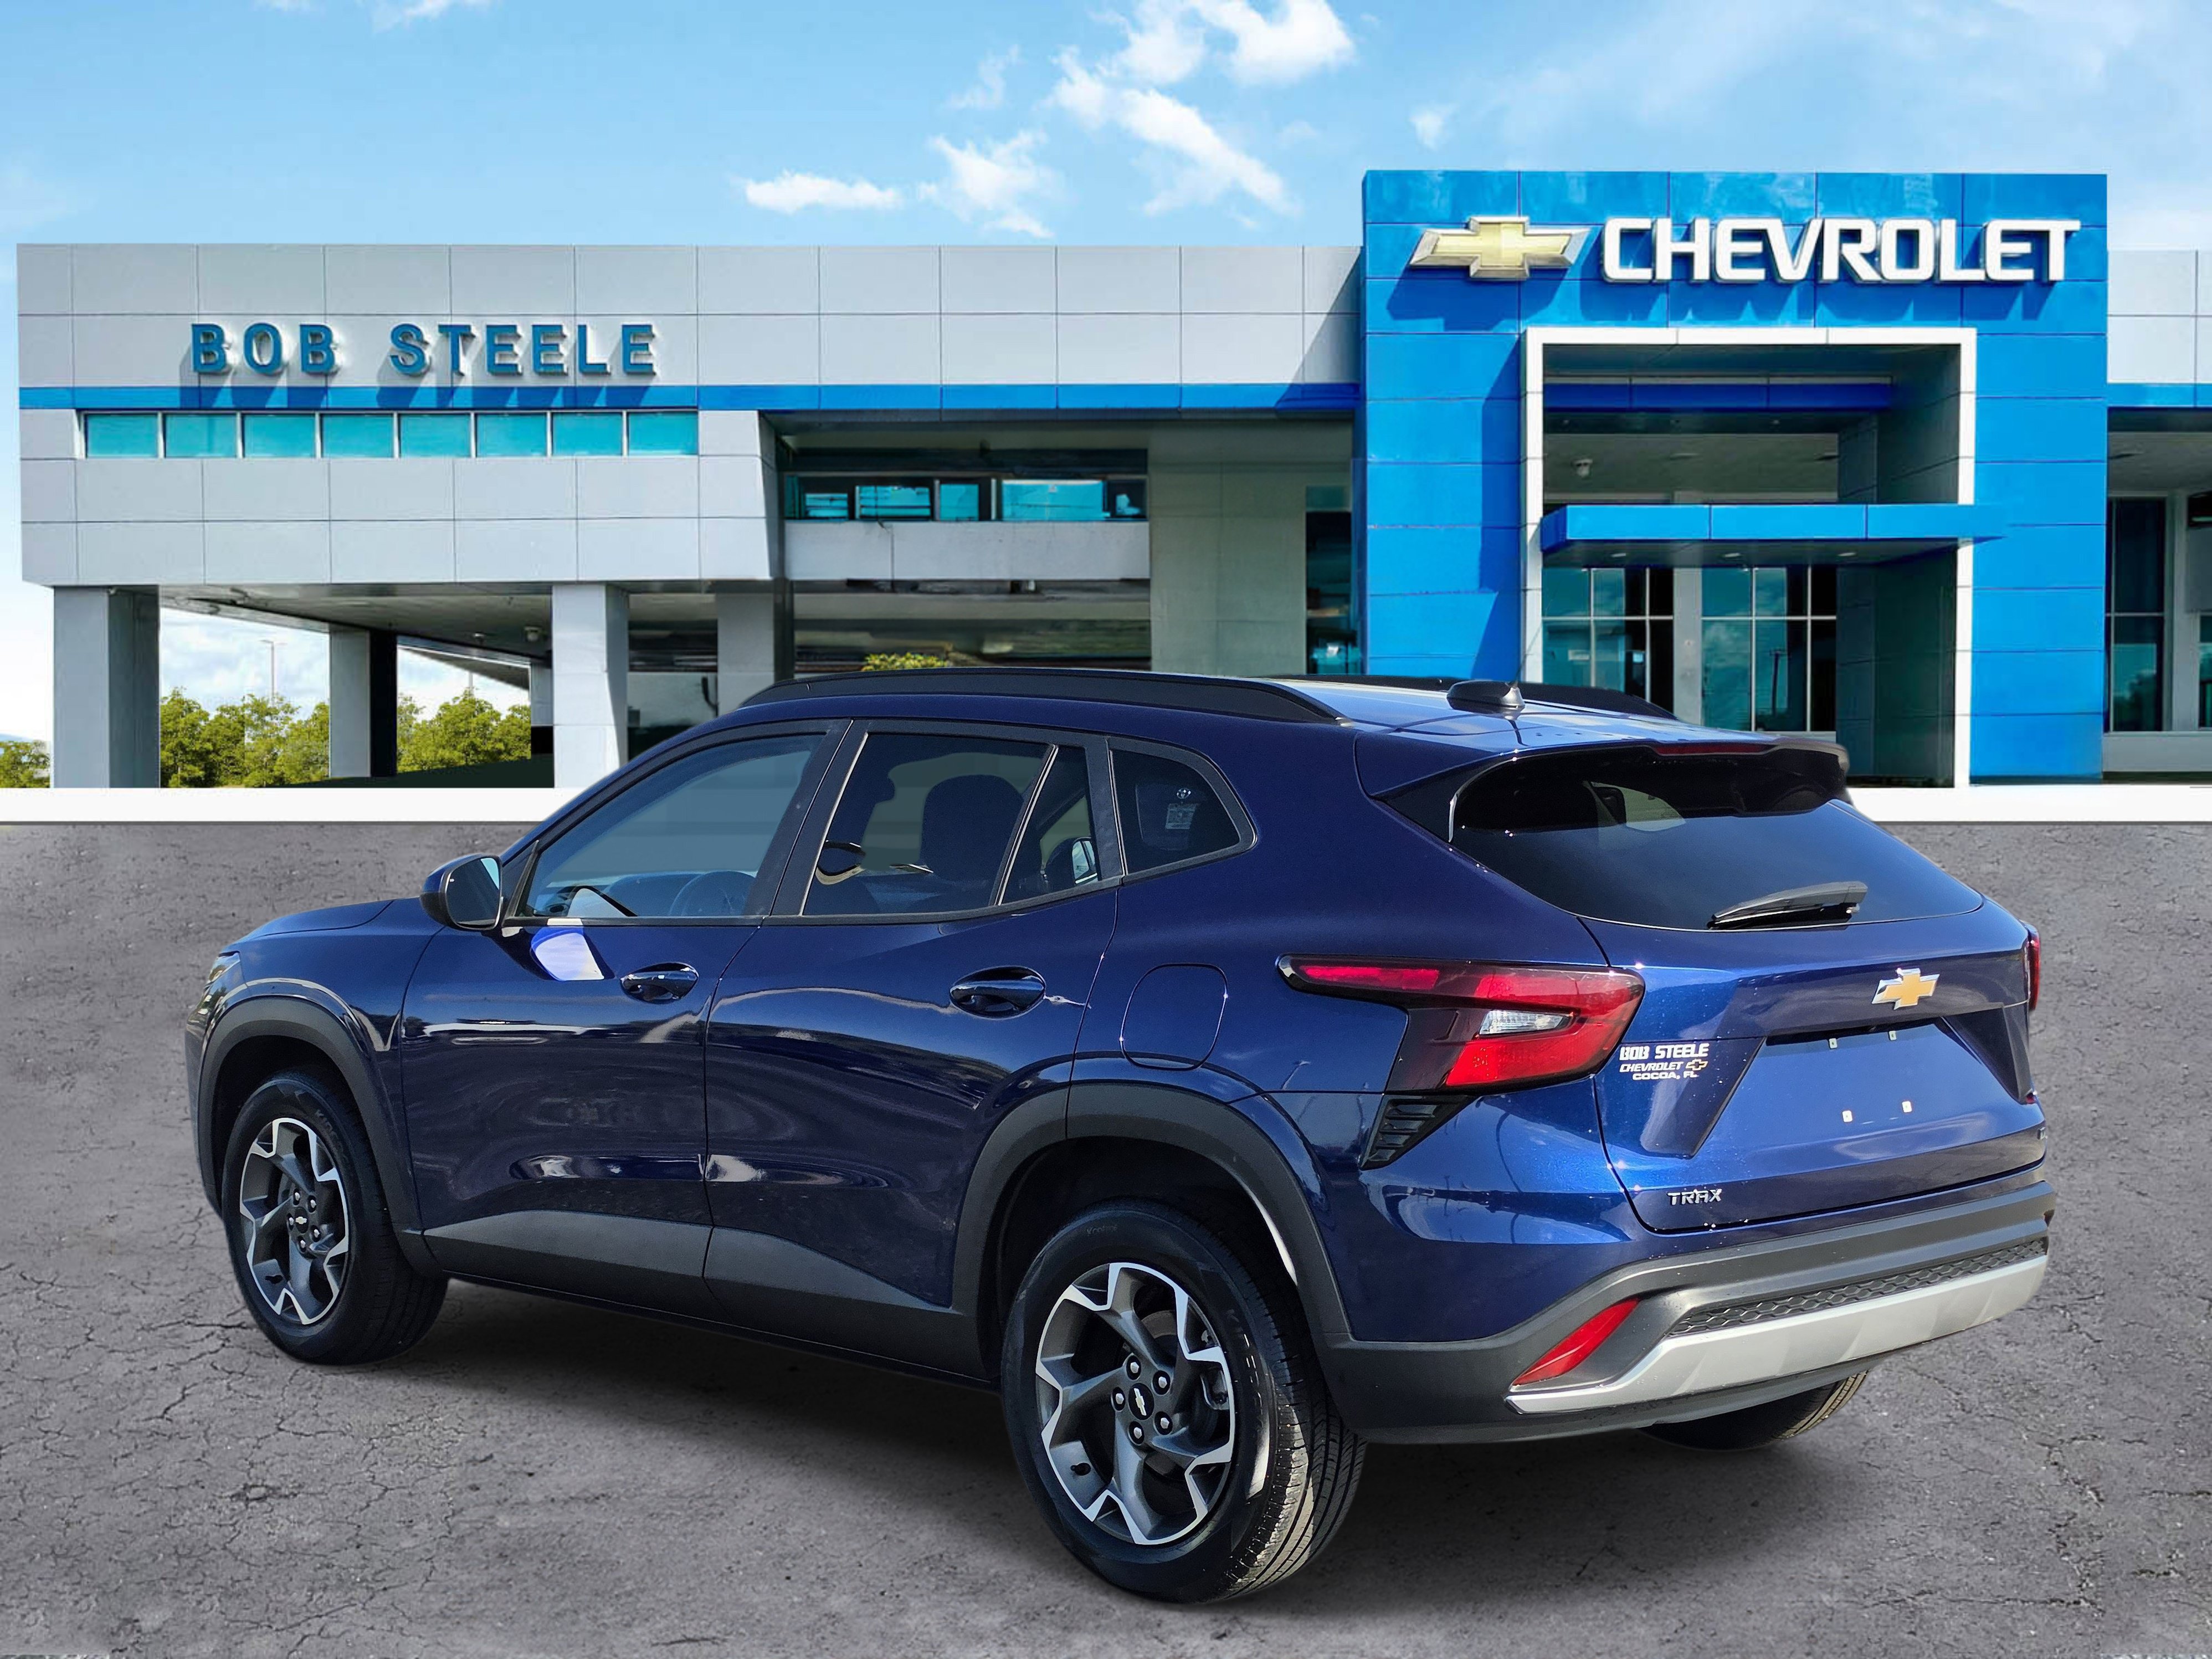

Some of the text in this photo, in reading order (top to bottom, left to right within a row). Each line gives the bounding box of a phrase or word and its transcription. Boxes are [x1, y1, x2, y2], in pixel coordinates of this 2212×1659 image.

[1603, 218, 2081, 282] CHEVROLET
[191, 322, 656, 375] BOB STEELE
[1619, 1043, 1710, 1060] BOB STEELE
[1619, 1062, 1684, 1072] CHEVROLET
[1667, 1189, 1722, 1205] TRAX
